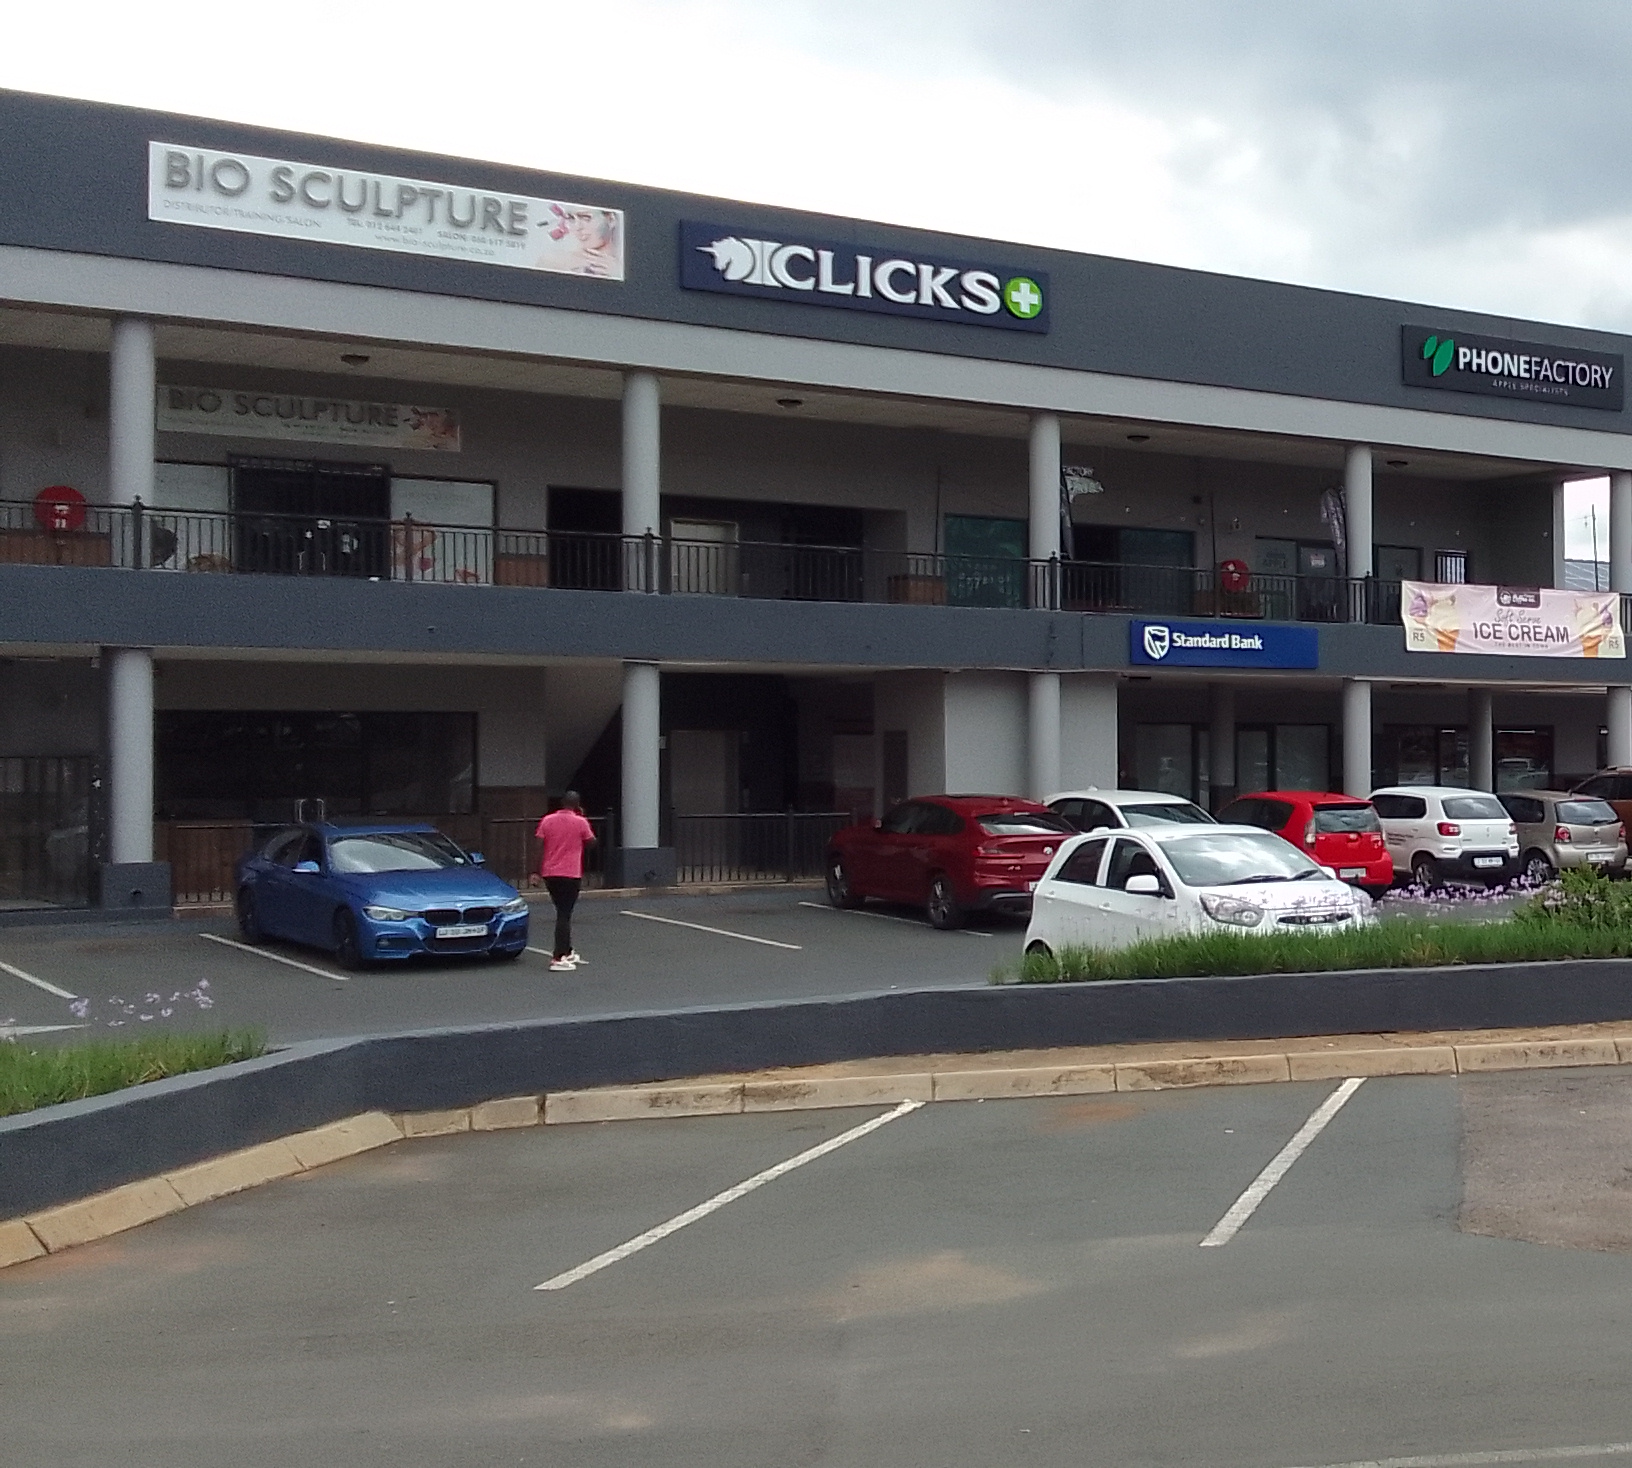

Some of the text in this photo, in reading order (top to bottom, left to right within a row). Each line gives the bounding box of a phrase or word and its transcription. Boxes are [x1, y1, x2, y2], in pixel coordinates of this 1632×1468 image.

[163, 150, 529, 236] BIO SCULPTURE
[771, 244, 1001, 315] CLICKS
[1458, 346, 1614, 389] PHONEFACTORY
[168, 388, 222, 413] BIO
[234, 394, 399, 427] SCULPTURE
[1494, 608, 1541, 626] Soft Serve
[1172, 632, 1263, 650] Standard Bank
[1413, 631, 1425, 642] R5
[1473, 622, 1570, 643] ICE CREAM
[1608, 640, 1619, 650] R5
